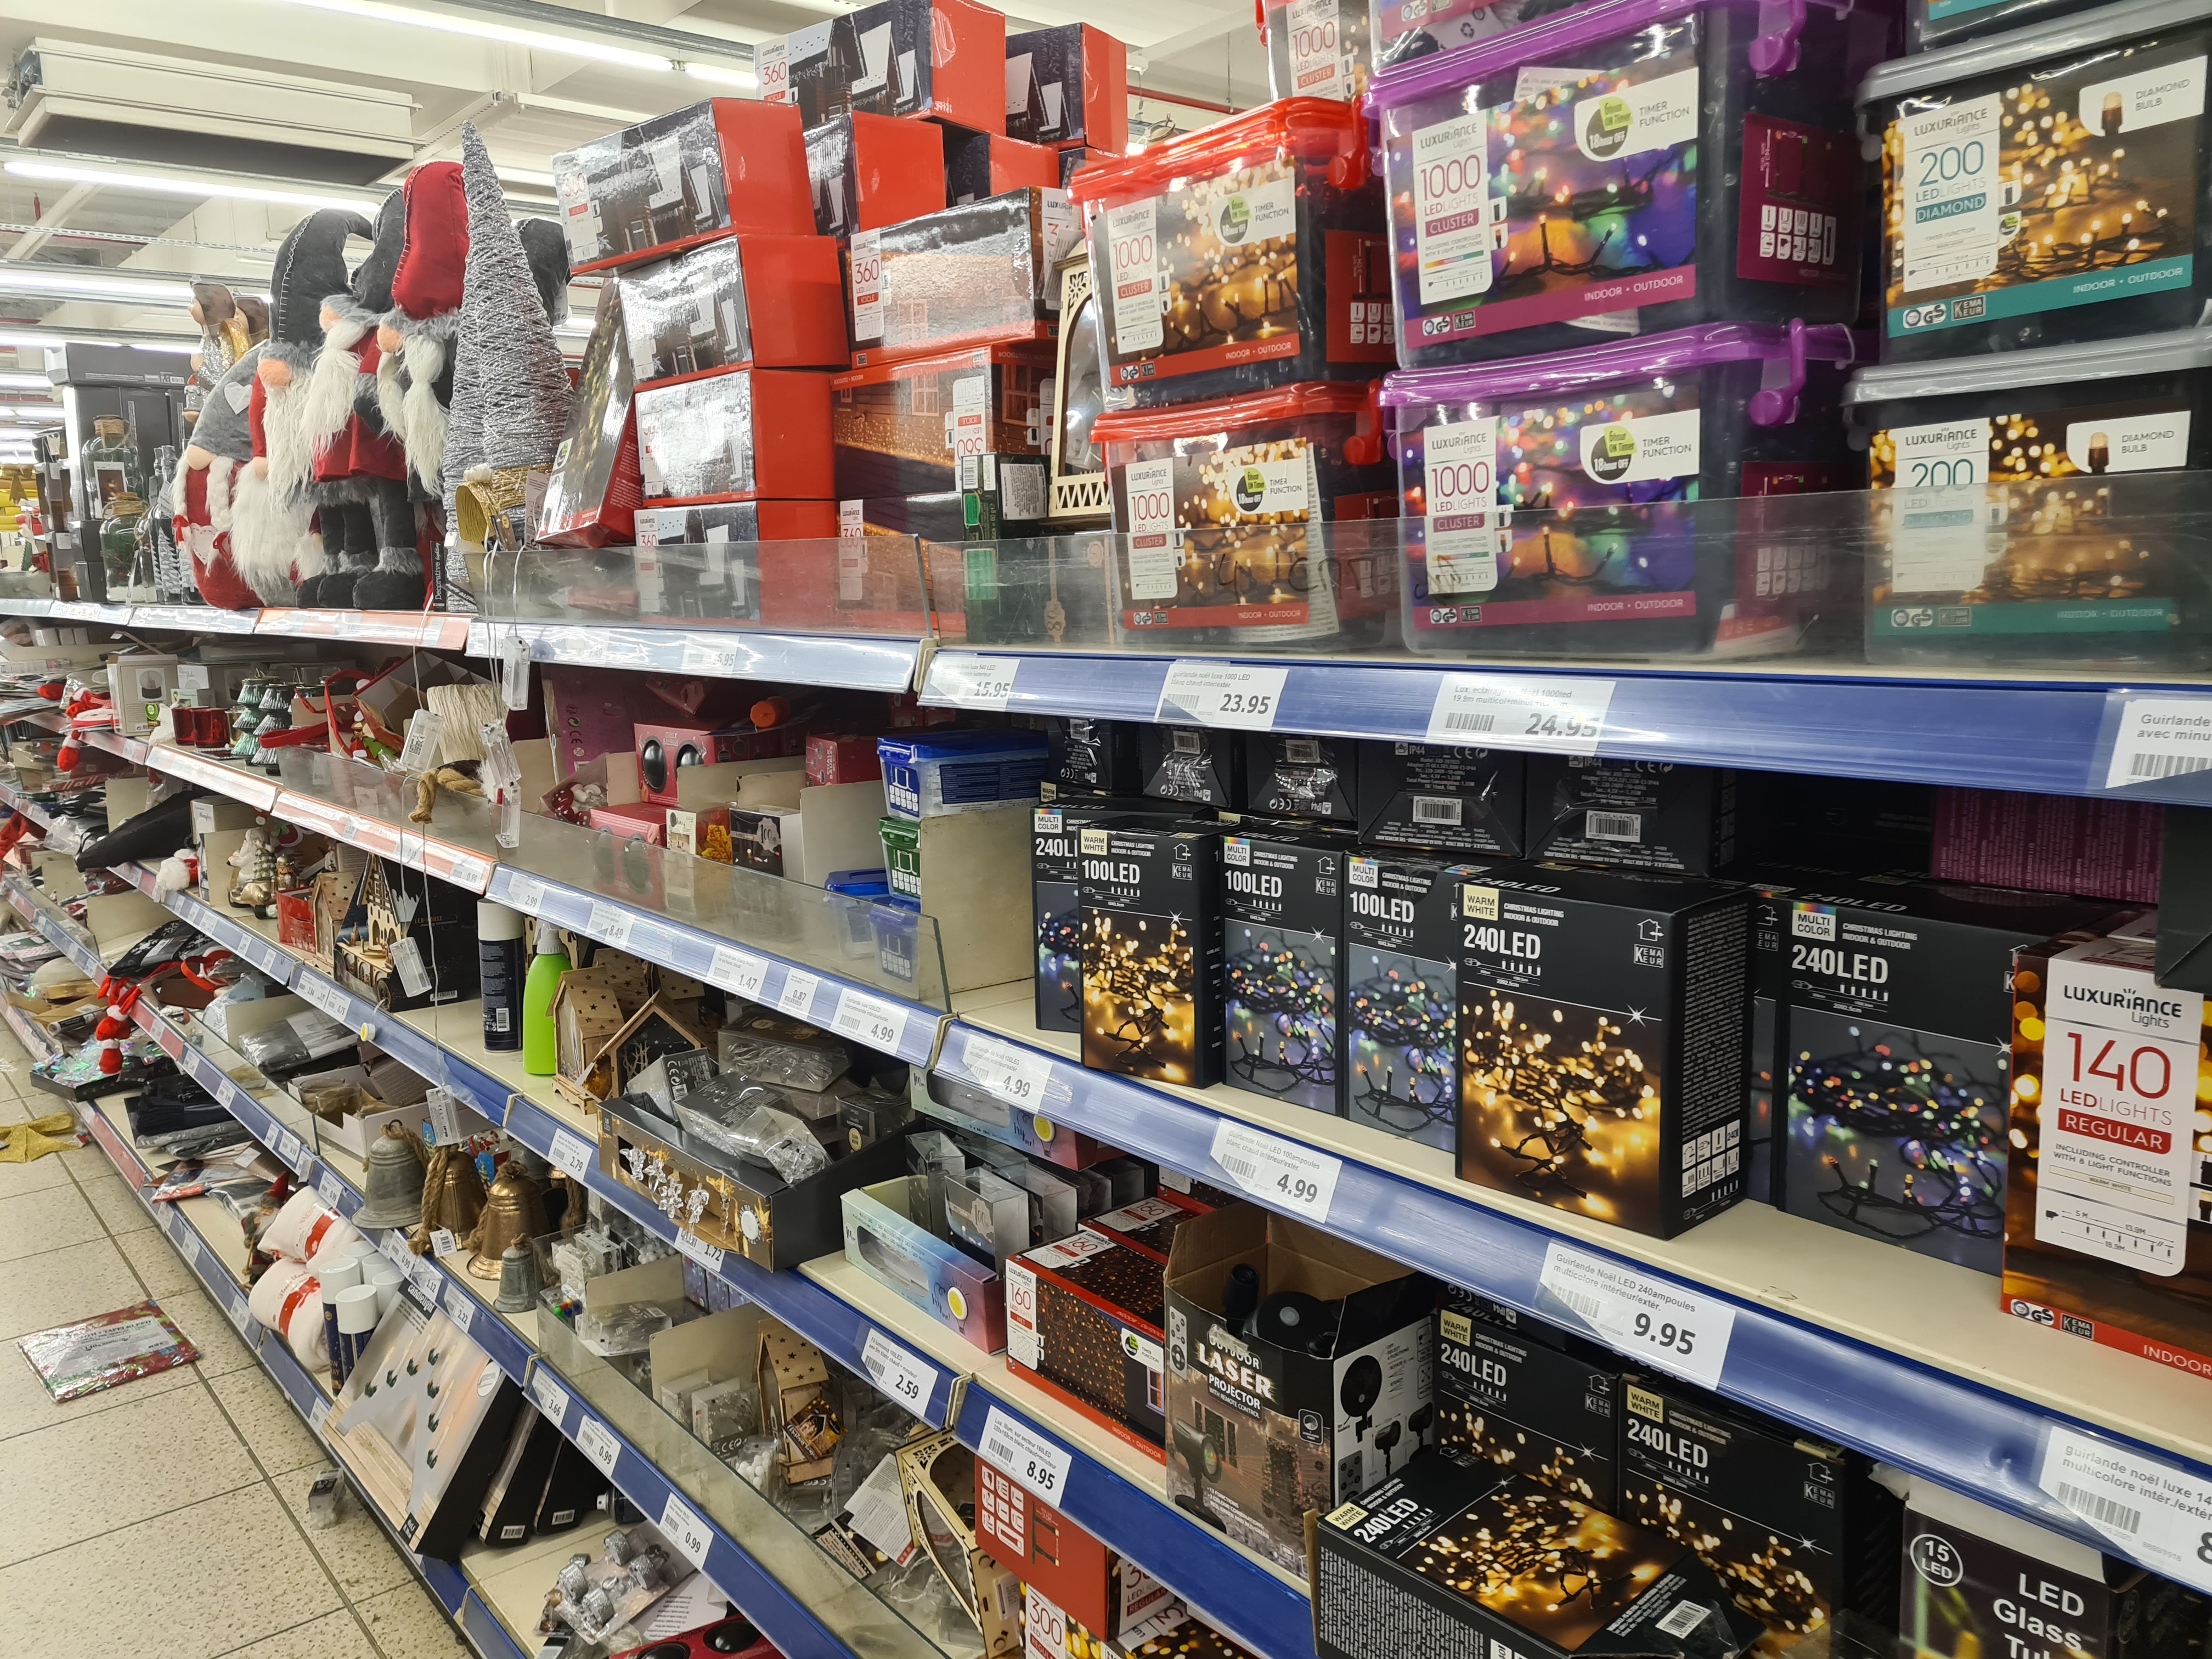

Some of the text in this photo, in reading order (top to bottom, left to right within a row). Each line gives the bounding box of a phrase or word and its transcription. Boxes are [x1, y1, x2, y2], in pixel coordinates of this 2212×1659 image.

[1293, 21, 1335, 60] 1000
[763, 61, 786, 86] 360
[2136, 79, 2191, 99] DIAMOND
[1639, 101, 1667, 116] TIMER
[2136, 97, 2163, 111] BULB
[1639, 106, 1690, 128] FUNCTION
[1919, 140, 1983, 187] 200
[1420, 154, 1480, 201] 1000
[1255, 202, 1273, 212] TIMER
[1255, 207, 1289, 222] FUNCTION
[1917, 196, 1985, 222] DIAMOND
[1430, 213, 1474, 234] CLUSTER
[1114, 235, 1152, 270] 1000
[855, 258, 878, 284] 360
[1121, 283, 1149, 296] CLUSTER
[1584, 275, 1684, 302] INDOOR OUTDOOR
[2074, 279, 2115, 292] INDOOR
[861, 294, 876, 304] ICICLE
[1643, 437, 1670, 447] TIMER
[2121, 429, 2174, 443] DIAMOND
[1464, 445, 1481, 454] Lights
[1643, 444, 1691, 458] FUNCTION
[1947, 442, 1970, 450] Lights
[2121, 442, 2147, 453] BULB
[1432, 461, 1489, 498] 1000
[1909, 459, 1973, 492] 200
[1270, 485, 1302, 494] FUNCTION
[1132, 492, 1169, 521] 1000
[1438, 516, 1480, 530] CLUSTER
[1136, 537, 1163, 547] CLUSTER
[1587, 599, 1684, 612] INDOOR OUTDOOR
[974, 681, 1010, 698] 15.95
[1542, 690, 1572, 698] 1000led
[1220, 693, 1271, 714] 23.95
[1525, 713, 1599, 737] 24.95
[2141, 714, 2210, 726] Guirlande
[2137, 730, 2170, 738] avec
[1409, 745, 1425, 755] IP44
[1584, 757, 1602, 767] IP44
[759, 825, 772, 844] 100
[1111, 840, 1135, 849] CHRISTMAS
[1227, 846, 1246, 854] MULTI
[1227, 854, 1246, 862] COLOR
[1082, 860, 1139, 884] 100LED
[1353, 865, 1374, 875] MULTI
[1383, 872, 1431, 885] CHRISTMAS LIGHTING
[1225, 870, 1282, 898] 100LED
[1353, 874, 1374, 884] COLOR
[1471, 878, 1561, 893] 240LED
[525, 895, 537, 907] 2.99
[1350, 891, 1414, 923] 100LED
[1468, 895, 1495, 906] WARM
[1468, 905, 1495, 916] WHITE
[1504, 903, 1564, 918] CHRISTMAS LIGHTING
[1798, 914, 1830, 926] MULTI
[609, 925, 623, 939] 8.49
[1798, 924, 1830, 936] COLOR
[1843, 923, 1917, 940] CHRISTMAS LIGHTING
[1464, 924, 1541, 959] 240LED
[1792, 944, 1888, 984] 240LED
[738, 974, 757, 990] 1.47
[793, 990, 806, 1001] 0.87
[871, 1024, 894, 1042] 4.99
[2067, 1032, 2171, 1099] 140
[1003, 1076, 1030, 1097] 4.99
[1013, 1122, 1026, 1141] Try
[2066, 1113, 2163, 1150] REGULAR
[1227, 1138, 1300, 1172] blanc chaud intérieur/extér.
[1229, 1130, 1320, 1170] Guirlande Noël LED 100ampoules
[570, 1156, 583, 1171] 2.79
[2056, 1143, 2170, 1177] INCLUDING CONTROLLER
[2053, 1152, 2075, 1162] WITH
[2088, 1160, 2114, 1172] LIGHT
[2118, 1167, 2171, 1186] FUNCTIONS
[1277, 1174, 1318, 1203] 4.99
[2089, 1177, 2131, 1192] WARM WHITE
[1138, 1203, 1165, 1216] 160
[2125, 1224, 2146, 1234] 13.9M
[1069, 1238, 1097, 1251] 160
[2106, 1241, 2125, 1251] 18.9M
[704, 1245, 722, 1262] 1.72
[427, 1279, 436, 1293] 1.12
[1554, 1265, 1661, 1312] multicolore intérieur/extér.
[1557, 1254, 1696, 1312] Guirlande Noël LED 240ampoules
[408, 1285, 435, 1313] candlelight
[1011, 1283, 1031, 1310] 160
[458, 1310, 468, 1324] 2.22
[1017, 1316, 1026, 1325] NET
[1443, 1319, 1468, 1333] WARM
[1443, 1327, 1468, 1342] WHITE
[1633, 1313, 1696, 1355] 9.95
[881, 1351, 889, 1360] blanc
[889, 1358, 900, 1367] chaud
[890, 1350, 902, 1361] 100LED
[1199, 1343, 1272, 1400] LASER
[1441, 1344, 1506, 1386] 240LED
[895, 1374, 918, 1399] 2.59
[1209, 1373, 1261, 1410] PROJECTOR
[549, 1399, 560, 1417] 3.66
[1209, 1387, 1260, 1419] WITH REMOTE CONTROL
[599, 1446, 612, 1464] 0.99
[994, 1425, 1013, 1441] 320x150cm
[1014, 1438, 1025, 1449] blanc
[1025, 1446, 1057, 1469] chaud+minuteur
[1022, 1436, 1035, 1448] secteur
[1037, 1445, 1051, 1458] 160LED
[1027, 1461, 1055, 1490] 8.95
[2063, 1456, 2135, 1493] multicolore
[2065, 1444, 2191, 1499] guirlande noël luxe
[1214, 1496, 1229, 1509] COLOUR
[1333, 1506, 1356, 1522] WARM
[685, 1532, 701, 1553] 0.99
[1925, 1539, 1949, 1562] 15
[1921, 1556, 1953, 1580] LED
[2019, 1572, 2084, 1617] LED
[1030, 1595, 1062, 1646] 300
[1994, 1598, 2082, 1651] Glass
